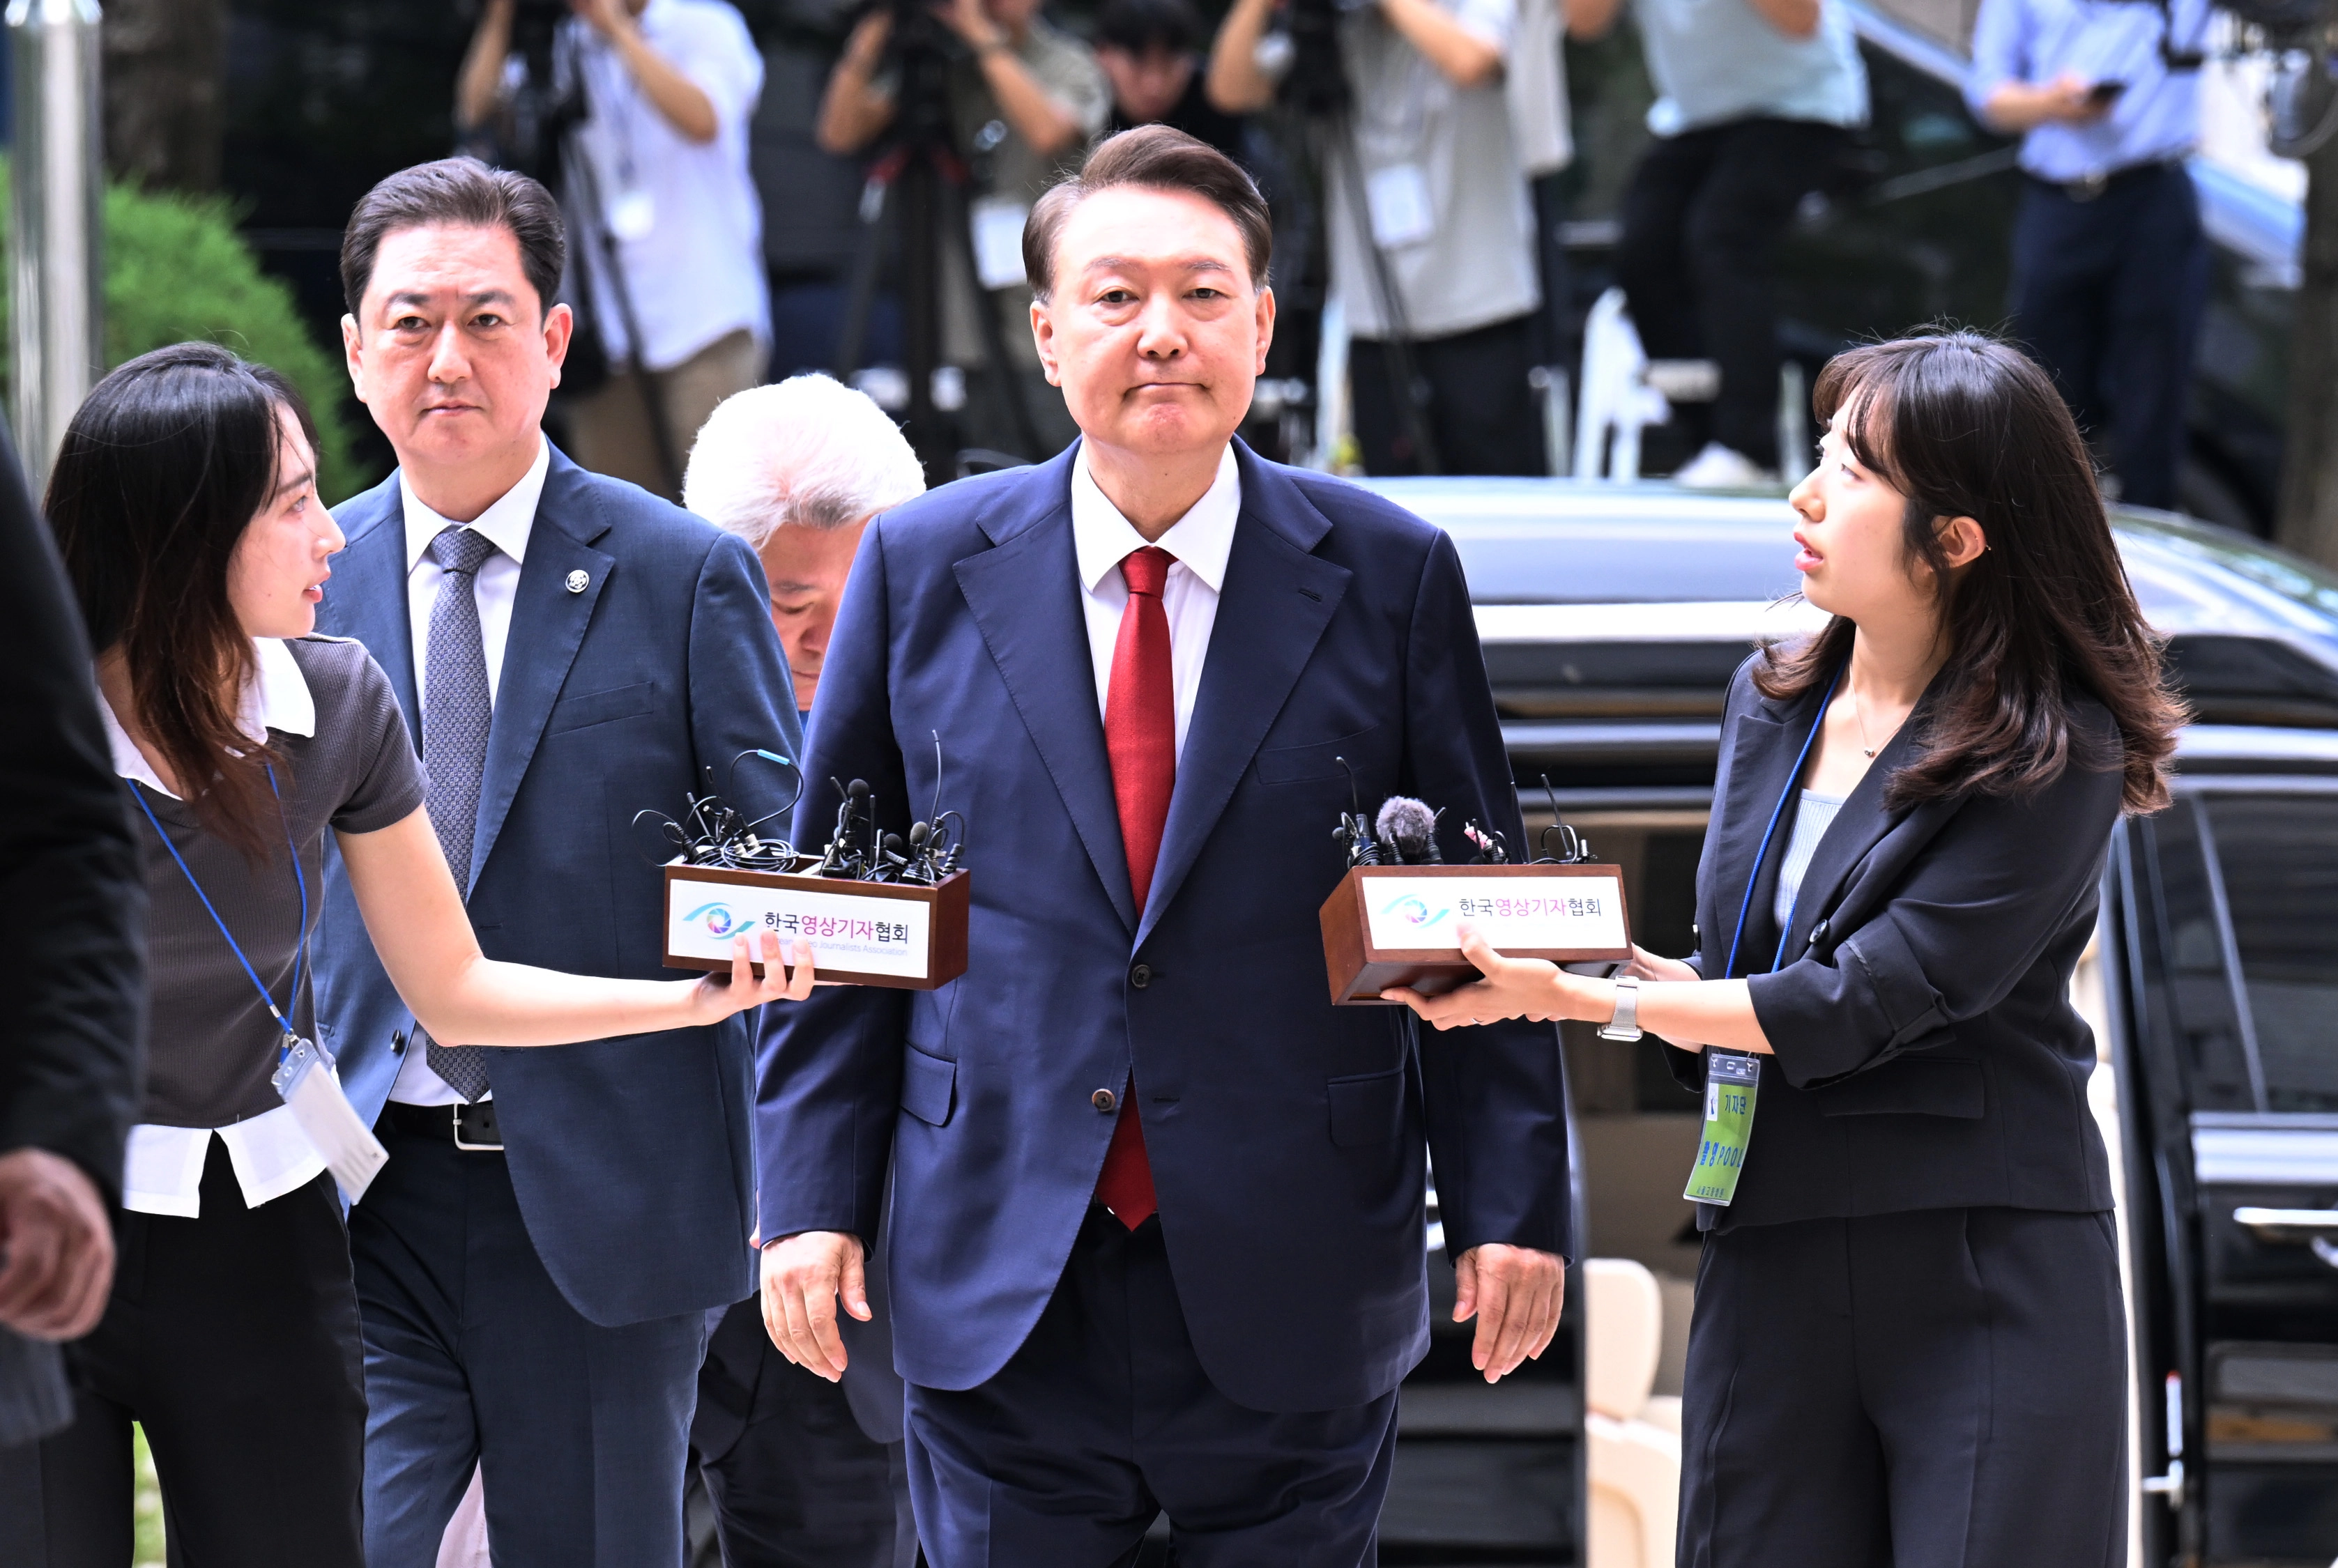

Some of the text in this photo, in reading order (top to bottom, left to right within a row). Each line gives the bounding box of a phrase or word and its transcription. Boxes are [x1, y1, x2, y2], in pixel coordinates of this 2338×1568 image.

[1459, 898, 1601, 916] 한국영상기자협회
[765, 912, 908, 944] 한국영상기자협회
[819, 941, 862, 952] Journalists
[863, 945, 908, 955] Association
[1725, 1095, 1746, 1114] 기자단
